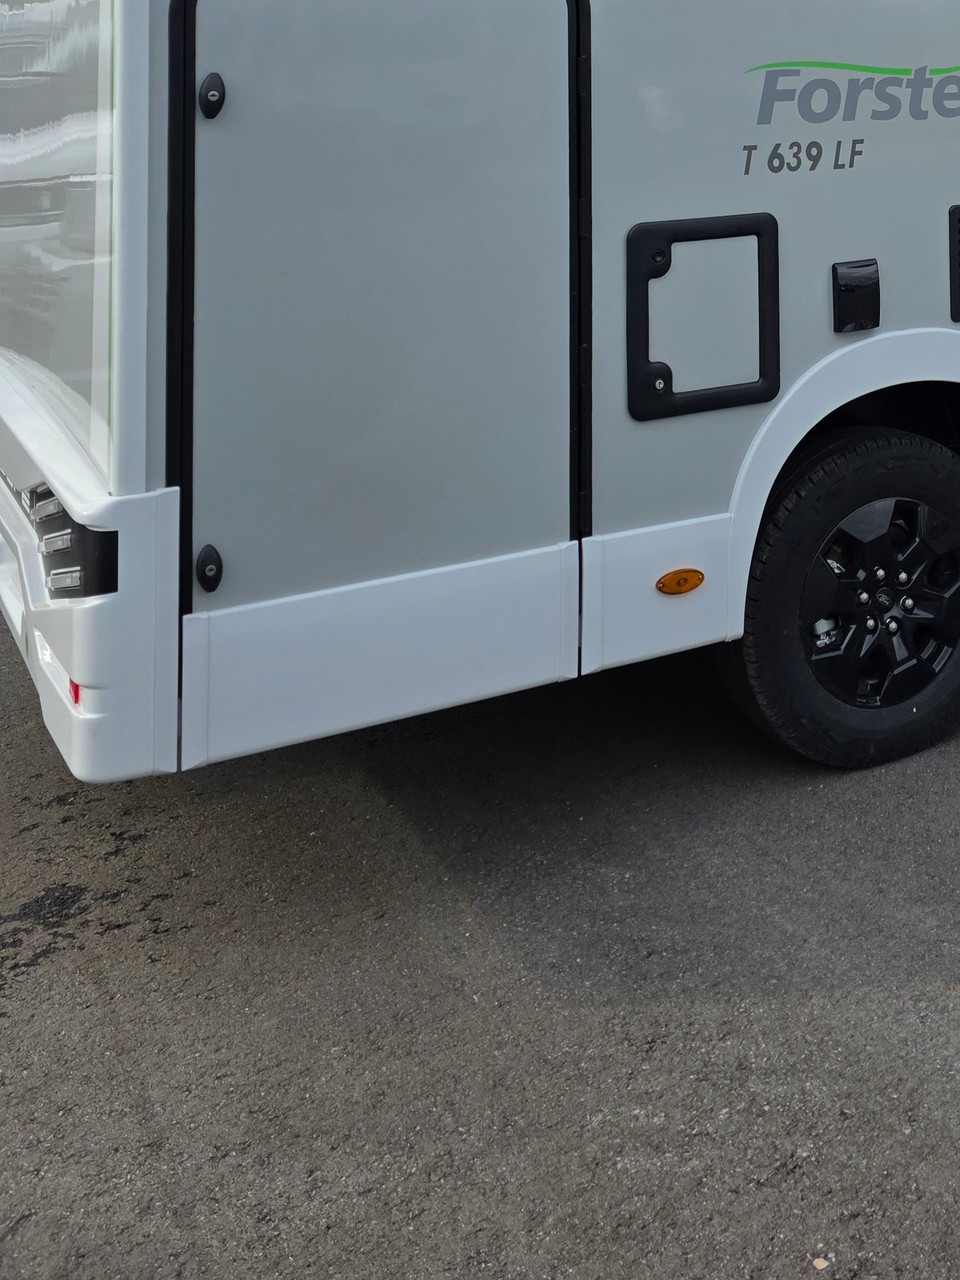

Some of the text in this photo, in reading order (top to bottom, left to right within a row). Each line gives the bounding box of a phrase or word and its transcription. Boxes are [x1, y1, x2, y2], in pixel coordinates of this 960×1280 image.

[742, 138, 864, 176] T 639 LF
